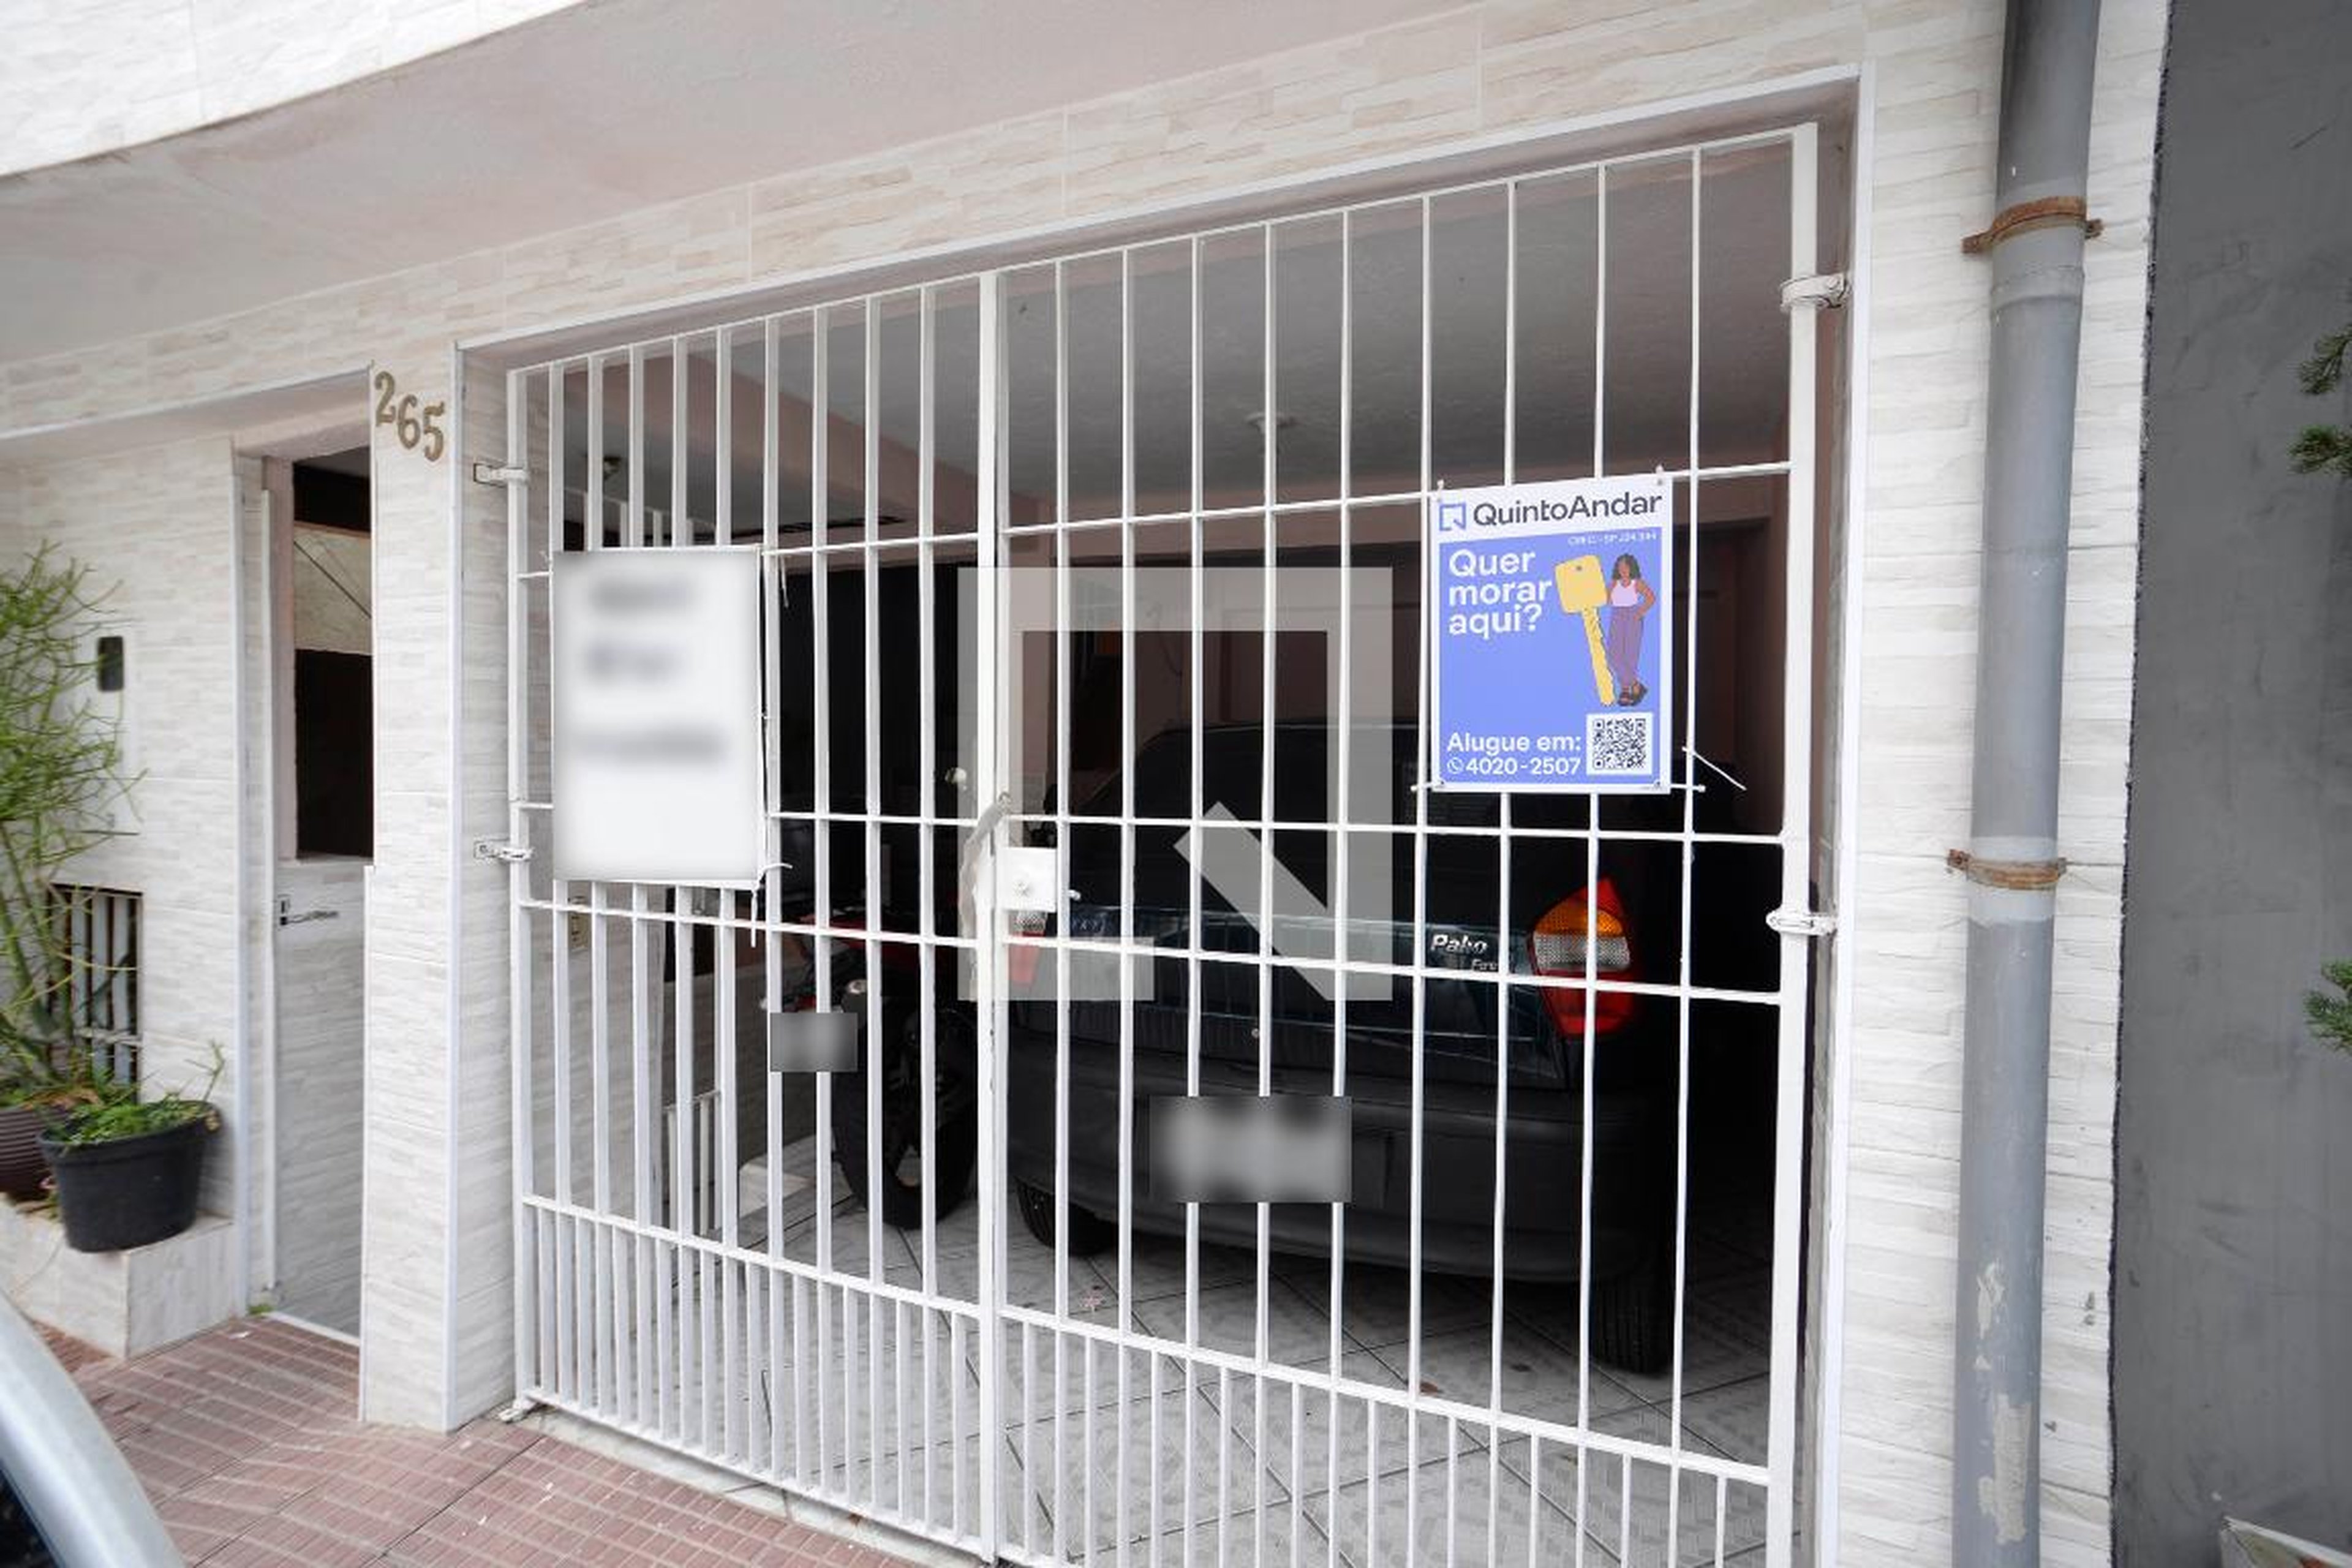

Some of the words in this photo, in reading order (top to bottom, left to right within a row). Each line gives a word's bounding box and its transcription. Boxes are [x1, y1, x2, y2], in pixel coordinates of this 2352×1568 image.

[375, 371, 445, 461] 265
[1473, 491, 1662, 526] QuintoAndar
[1450, 549, 1536, 576] Quer
[1449, 579, 1552, 606] morar
[1449, 603, 1542, 640] aqui?
[1447, 732, 1530, 756] Alugue
[1537, 736, 1581, 751] em:
